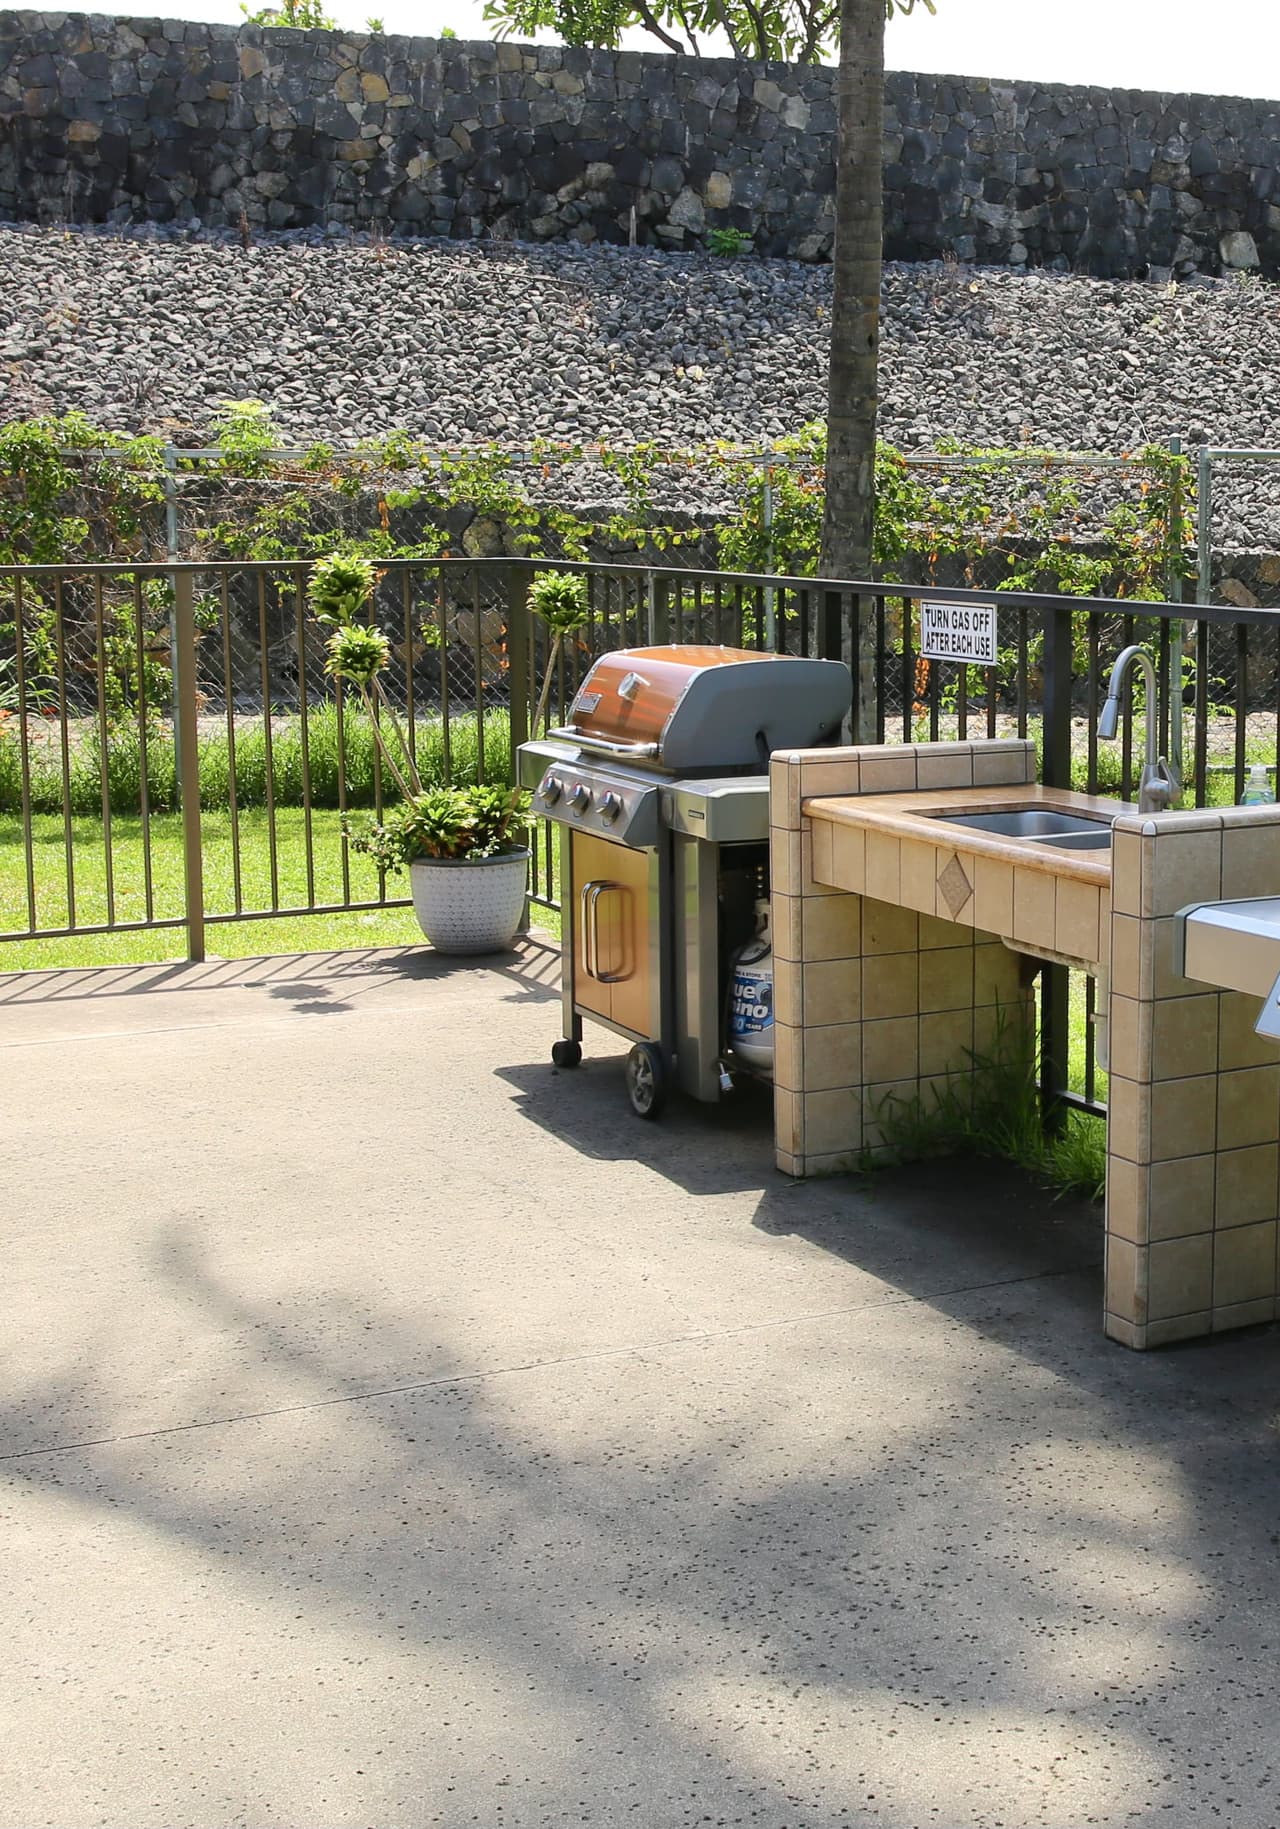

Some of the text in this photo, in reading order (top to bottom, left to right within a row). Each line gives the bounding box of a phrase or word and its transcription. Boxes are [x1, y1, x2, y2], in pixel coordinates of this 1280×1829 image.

[925, 608, 990, 632] TURN GAS OFF
[926, 631, 990, 656] AFTER EACH USE
[734, 983, 756, 999] ue
[734, 998, 769, 1019] ino
